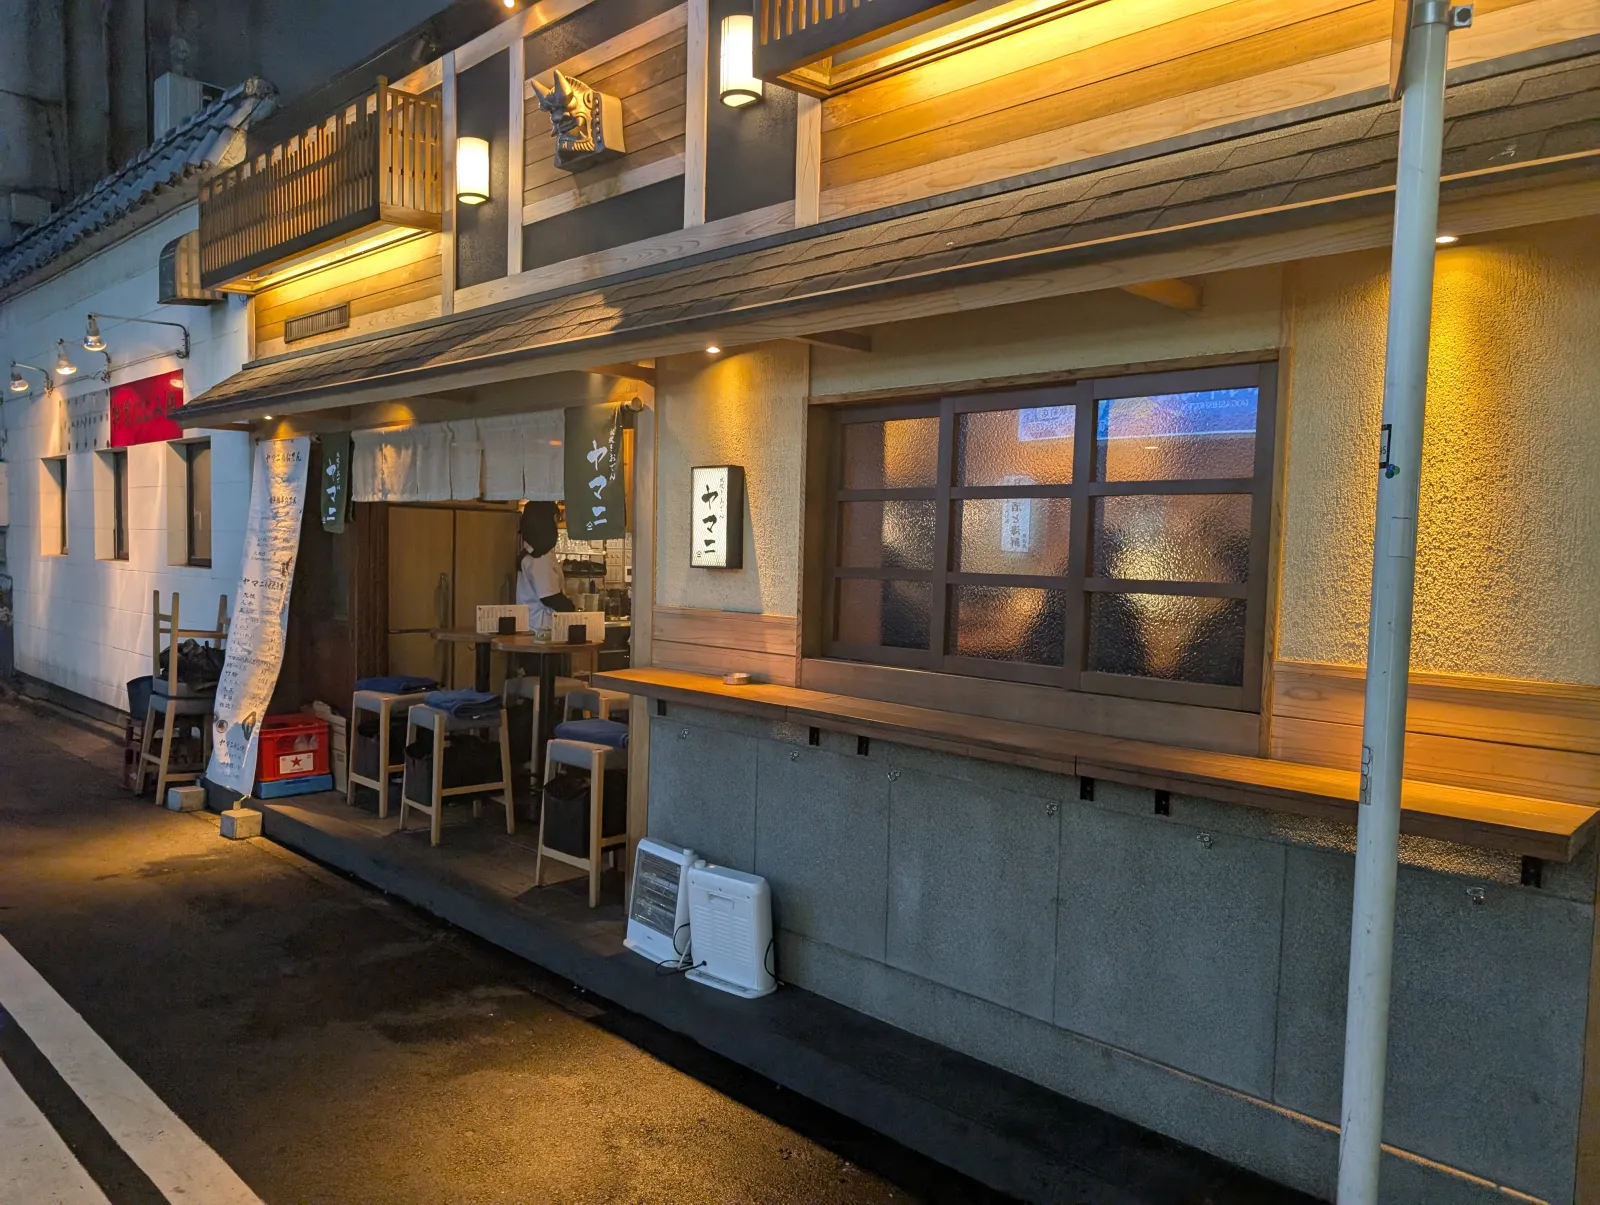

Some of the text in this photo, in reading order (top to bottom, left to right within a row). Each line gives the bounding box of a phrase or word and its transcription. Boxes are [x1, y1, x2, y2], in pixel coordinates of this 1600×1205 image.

[326, 457, 337, 521] ヤマニ
[587, 439, 608, 525] ヤマニ
[701, 484, 719, 554] ヤマニ
